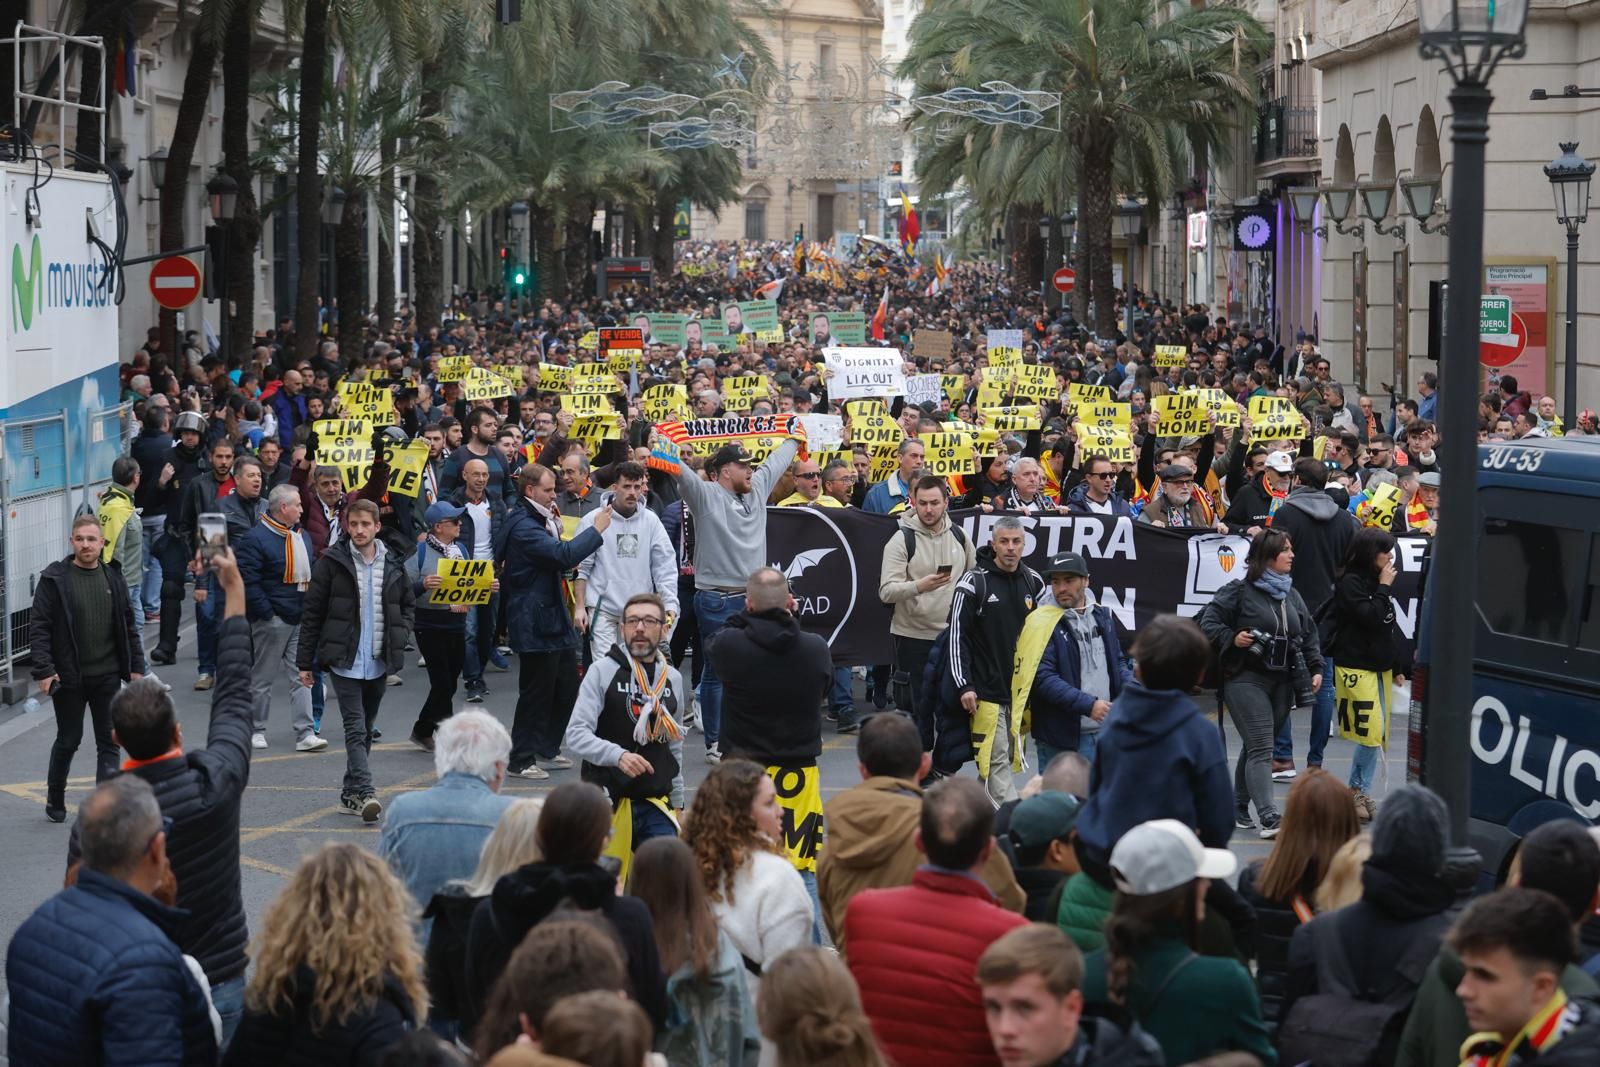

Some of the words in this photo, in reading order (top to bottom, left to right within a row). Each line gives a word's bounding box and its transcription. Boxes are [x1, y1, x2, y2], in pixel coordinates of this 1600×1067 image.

[600, 330, 612, 338] SE
[614, 330, 642, 339] VENDE
[994, 347, 1013, 356] LIM
[845, 358, 894, 367] DIGNITAT
[580, 365, 608, 375] LIM
[1025, 366, 1050, 377] LIM
[539, 380, 568, 390] HOM
[733, 377, 759, 389] LIM
[846, 374, 870, 384] LIM
[873, 374, 893, 383] OUT
[356, 390, 383, 404] LIM
[468, 385, 508, 398] HOME
[647, 385, 675, 400] LIM
[1017, 385, 1056, 397] HOME
[1078, 385, 1104, 397] LIM
[572, 395, 600, 408] LIM
[727, 398, 753, 409] HO
[1167, 396, 1198, 410] LIM
[1258, 400, 1291, 414] LIM
[363, 404, 377, 412] GO
[1094, 408, 1117, 416] LIM
[645, 409, 674, 420] HOM
[1174, 411, 1192, 419] GO
[1217, 412, 1238, 424] ME
[1268, 415, 1284, 423] GO
[684, 417, 750, 436] VALENCIA
[754, 416, 776, 432] C.F.
[867, 417, 883, 426] GO
[994, 416, 1027, 429] LIM
[1158, 420, 1208, 434] HOME
[325, 421, 363, 436] LIM
[577, 424, 610, 437] LIM
[1086, 426, 1117, 436] LIM
[1252, 424, 1302, 438] HOME
[851, 428, 900, 442] HOME
[931, 434, 961, 448] LIM
[335, 437, 354, 446] GO
[758, 438, 772, 446] GO
[1097, 437, 1113, 446] GO
[871, 445, 898, 458] OME
[939, 448, 954, 458] GO
[973, 442, 994, 454] ME
[1083, 448, 1131, 460] HOME
[317, 449, 375, 463] HOME
[1482, 447, 1546, 472] 30-53
[924, 459, 972, 473] HOME
[1372, 506, 1392, 526] HO
[450, 561, 486, 577] LIM
[456, 578, 474, 587] GO
[432, 588, 490, 606] HOME
[1338, 698, 1374, 736] ME
[1470, 695, 1600, 819] OLIC
[782, 807, 824, 859] ME
